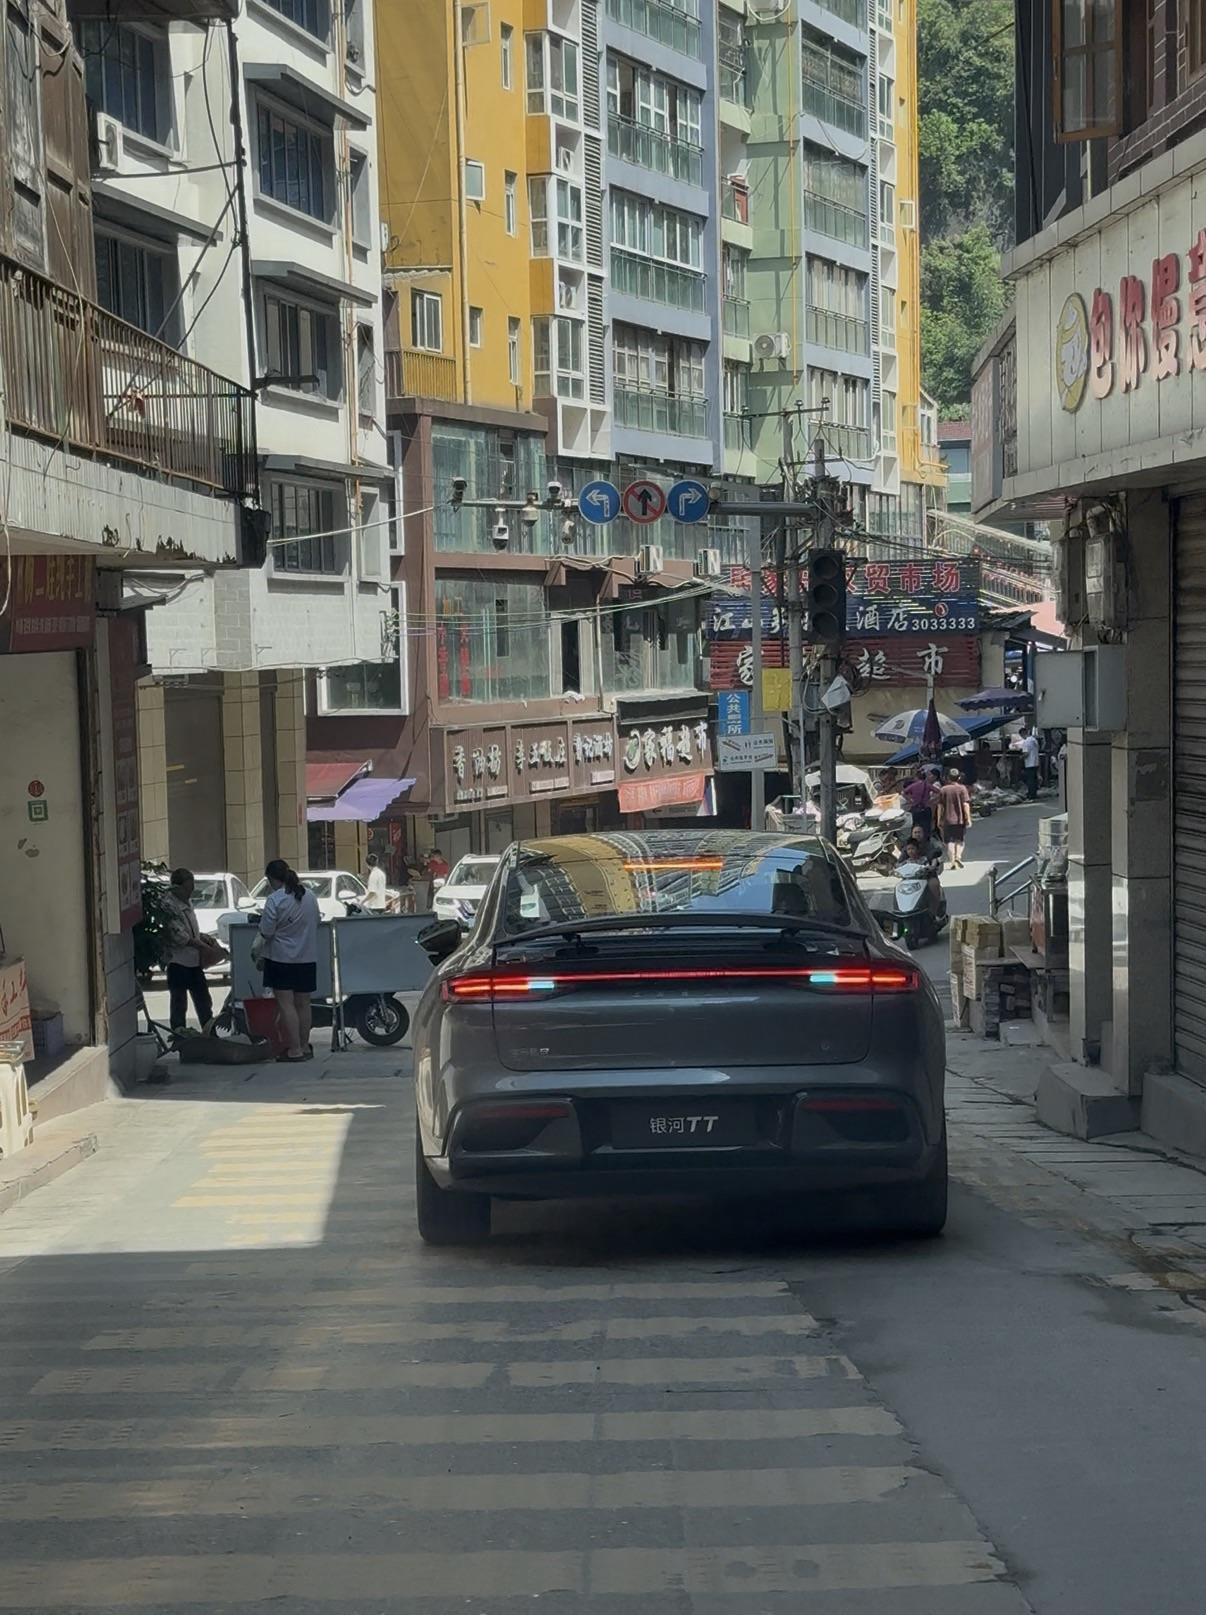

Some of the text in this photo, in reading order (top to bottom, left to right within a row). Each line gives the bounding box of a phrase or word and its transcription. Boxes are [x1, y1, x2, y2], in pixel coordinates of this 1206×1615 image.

[911, 617, 976, 631] 3033333
[737, 643, 948, 686] 家超市
[650, 1116, 719, 1134] 银河TT
